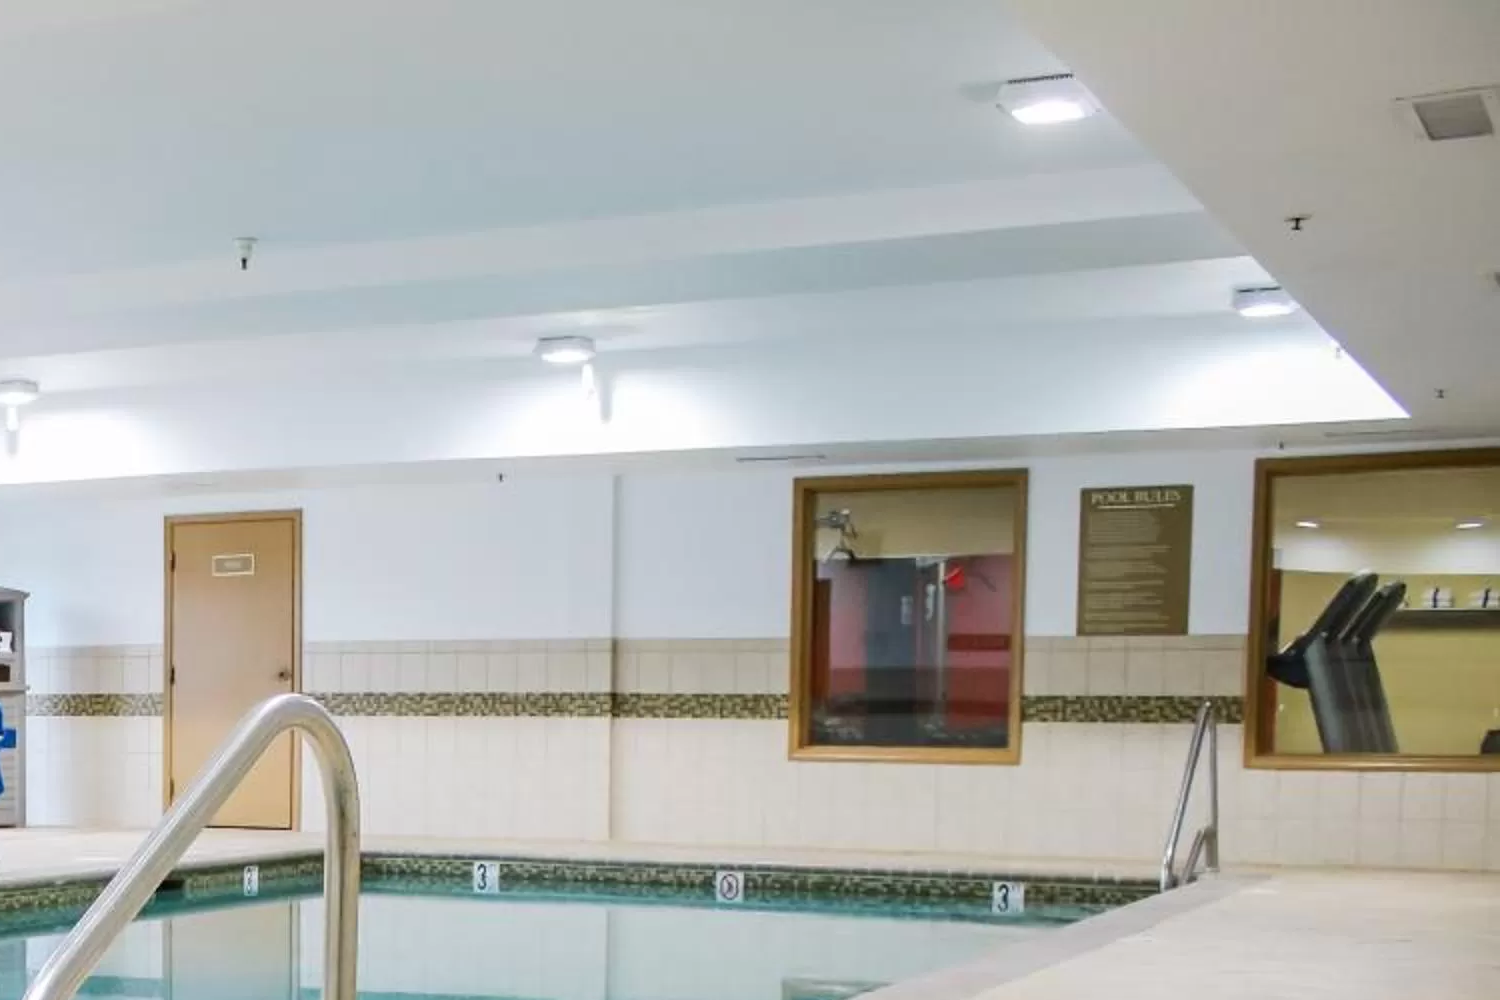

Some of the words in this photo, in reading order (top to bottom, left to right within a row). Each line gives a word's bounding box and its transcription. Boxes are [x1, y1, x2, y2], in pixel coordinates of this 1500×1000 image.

[1091, 491, 1130, 505] POOL
[1134, 489, 1182, 503] RULES
[477, 863, 487, 890] 3
